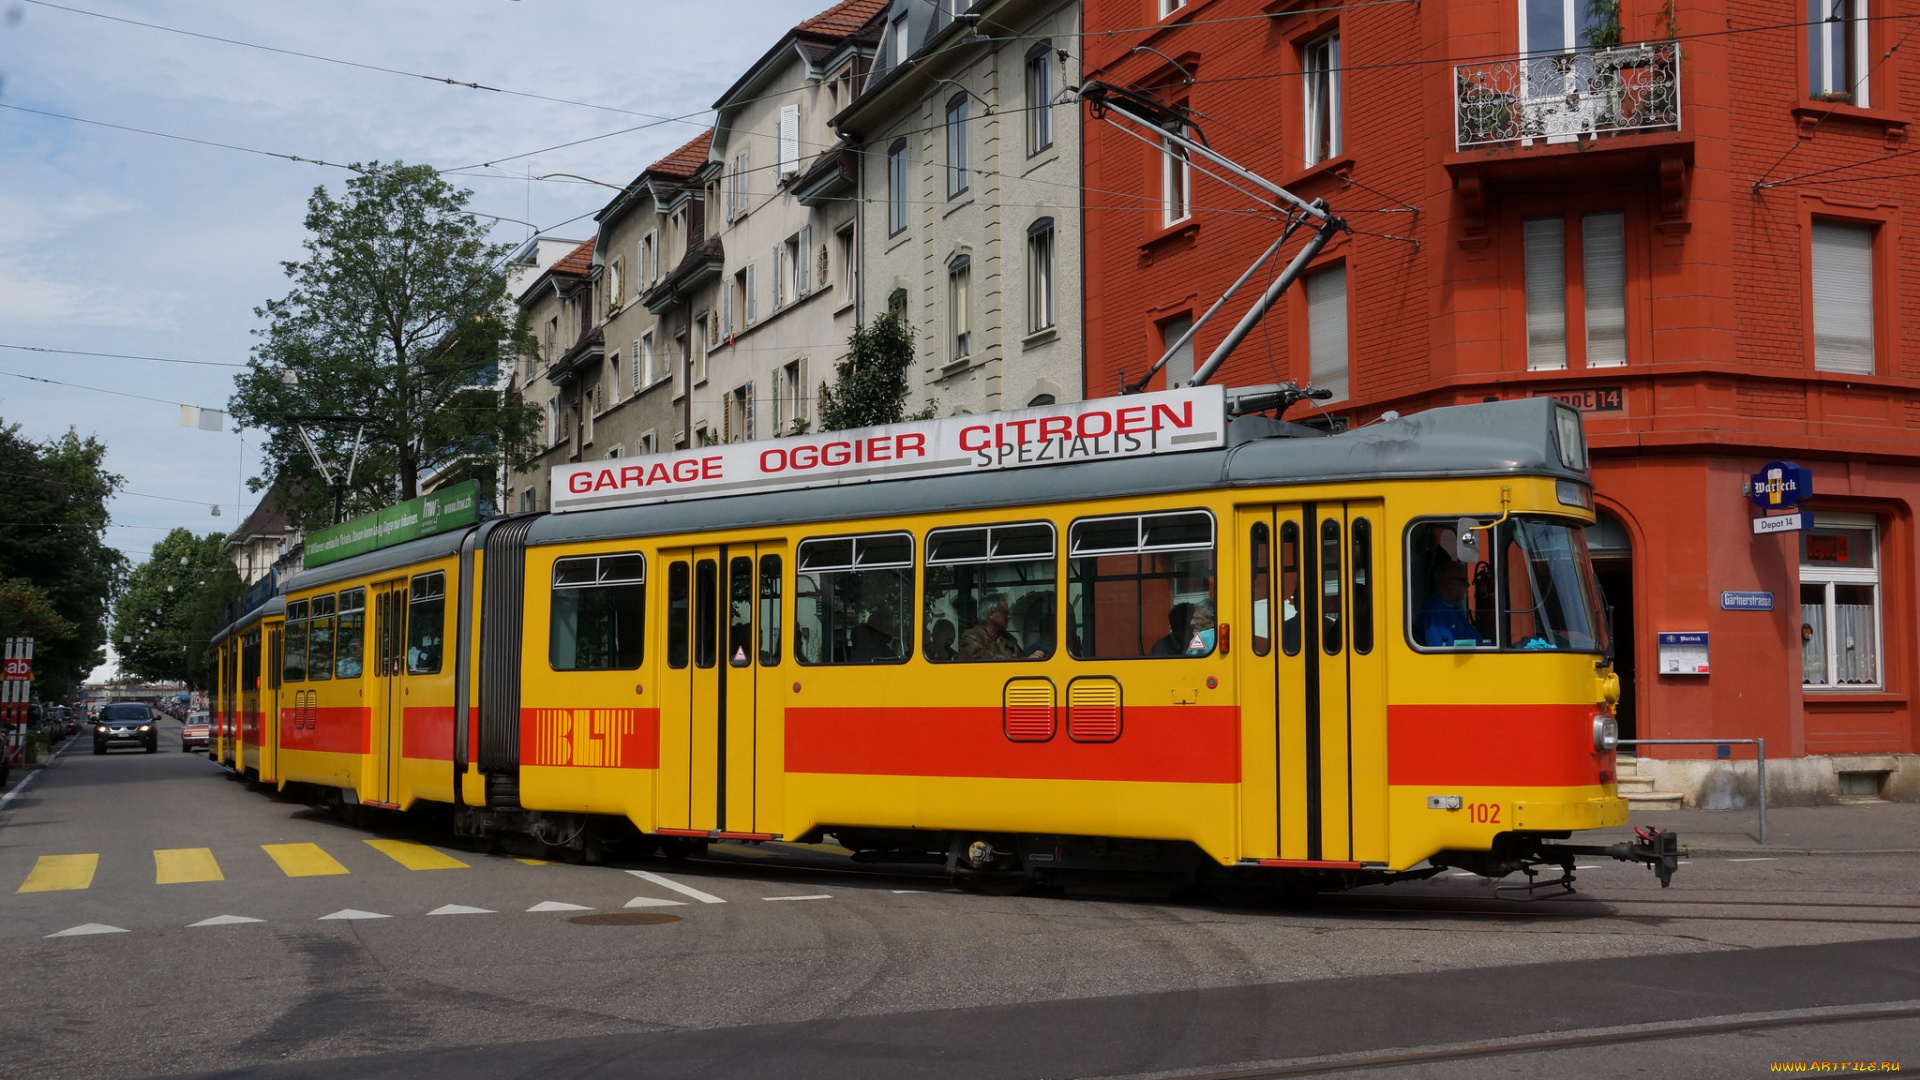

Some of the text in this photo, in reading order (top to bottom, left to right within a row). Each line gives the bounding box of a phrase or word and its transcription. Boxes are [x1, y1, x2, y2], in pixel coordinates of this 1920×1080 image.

[1599, 390, 1619, 407] 14
[569, 401, 1193, 494] GARAGE OGGIER CITROEN
[977, 426, 1165, 467] SPEZIALIST
[1755, 479, 1797, 497] Warteck
[1761, 518, 1793, 530] Depot 14
[1725, 592, 1772, 607] Gärtnerstrasse
[7, 660, 28, 674] ab
[536, 709, 634, 767] BLT
[1467, 803, 1501, 824] 102
